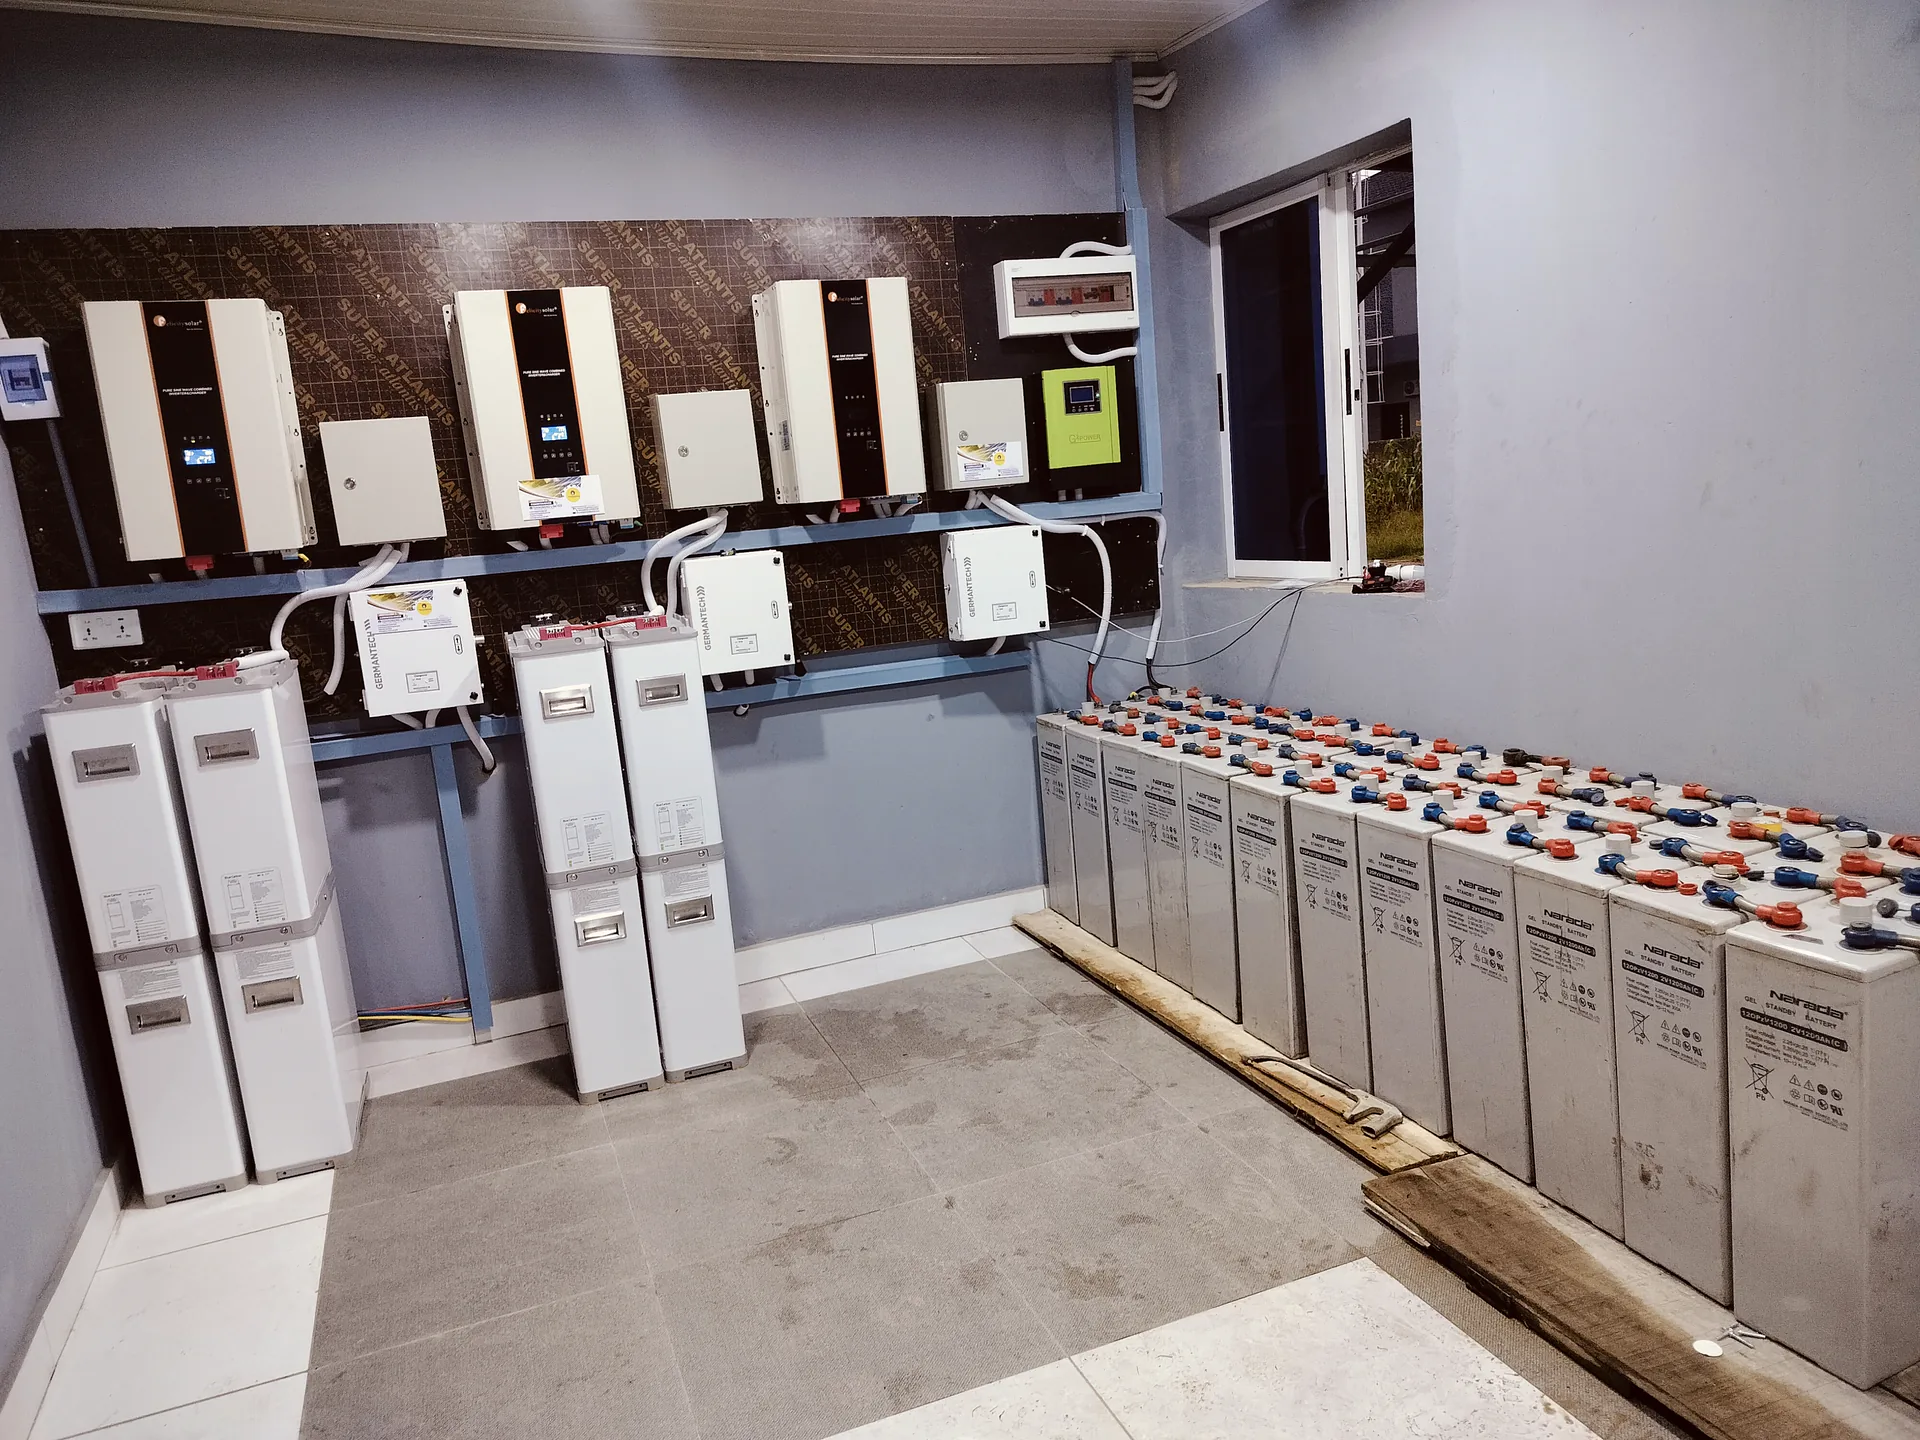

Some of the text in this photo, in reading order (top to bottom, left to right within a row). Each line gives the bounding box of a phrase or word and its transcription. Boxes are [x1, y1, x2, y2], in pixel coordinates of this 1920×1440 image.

[683, 241, 743, 316] ATLANTIS
[577, 240, 682, 365] SUPER ATLANTIS
[670, 289, 712, 341] SUPER
[337, 298, 456, 427] SUPER ATLANTIS
[840, 564, 892, 625] ATLANTIS
[884, 557, 919, 601] SUPER
[963, 566, 976, 618] GERMANTECH
[698, 596, 712, 651] GERMANTECH
[828, 606, 865, 649] SUPER
[1196, 791, 1222, 804] Narada
[1247, 812, 1276, 827] Narada
[1311, 832, 1346, 847] Narada
[1380, 852, 1417, 869] Narada
[1458, 878, 1501, 898] Narada
[1541, 919, 1562, 930] STANDBY
[1567, 927, 1589, 939] BATTERY
[1543, 908, 1592, 931] Narada
[1640, 954, 1665, 968] STANDBY
[1671, 965, 1696, 979] BATTERY
[1643, 943, 1701, 970] Narada
[1744, 995, 1838, 1030] GEL STANDBY BATTERY
[1769, 990, 1844, 1021] Narada
[1755, 1091, 1766, 1102] Pb
